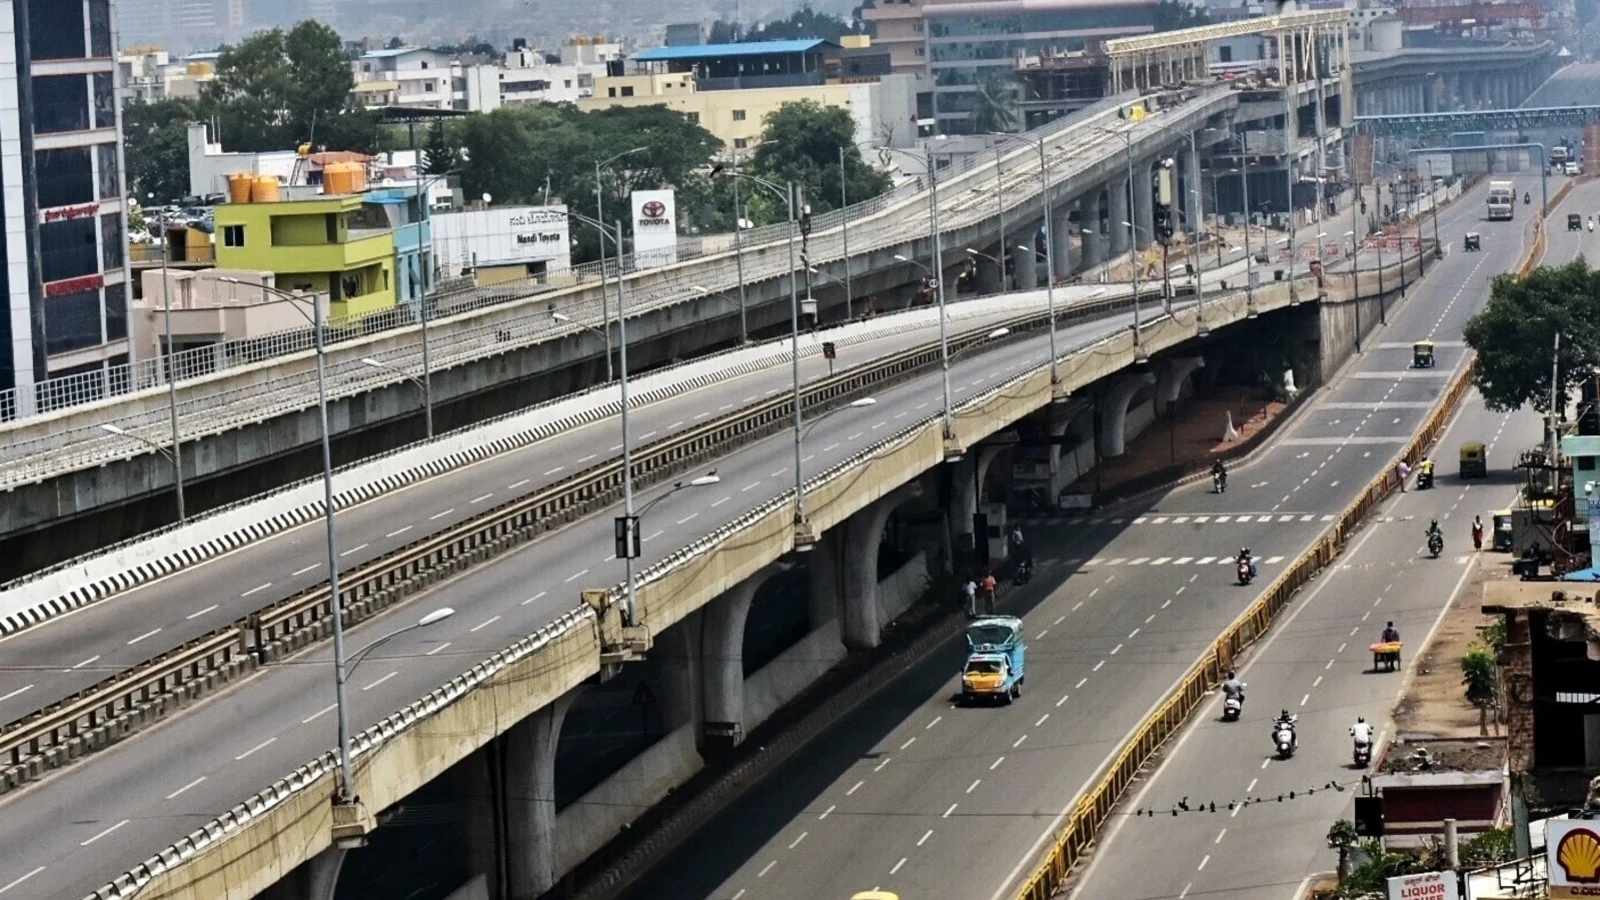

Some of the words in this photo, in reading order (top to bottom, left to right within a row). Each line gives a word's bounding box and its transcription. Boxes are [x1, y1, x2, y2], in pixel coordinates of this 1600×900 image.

[639, 218, 670, 226] TOYOTA
[517, 233, 537, 244] Nandi
[538, 232, 560, 244] Toyota
[1401, 884, 1445, 898] LIQUOR
